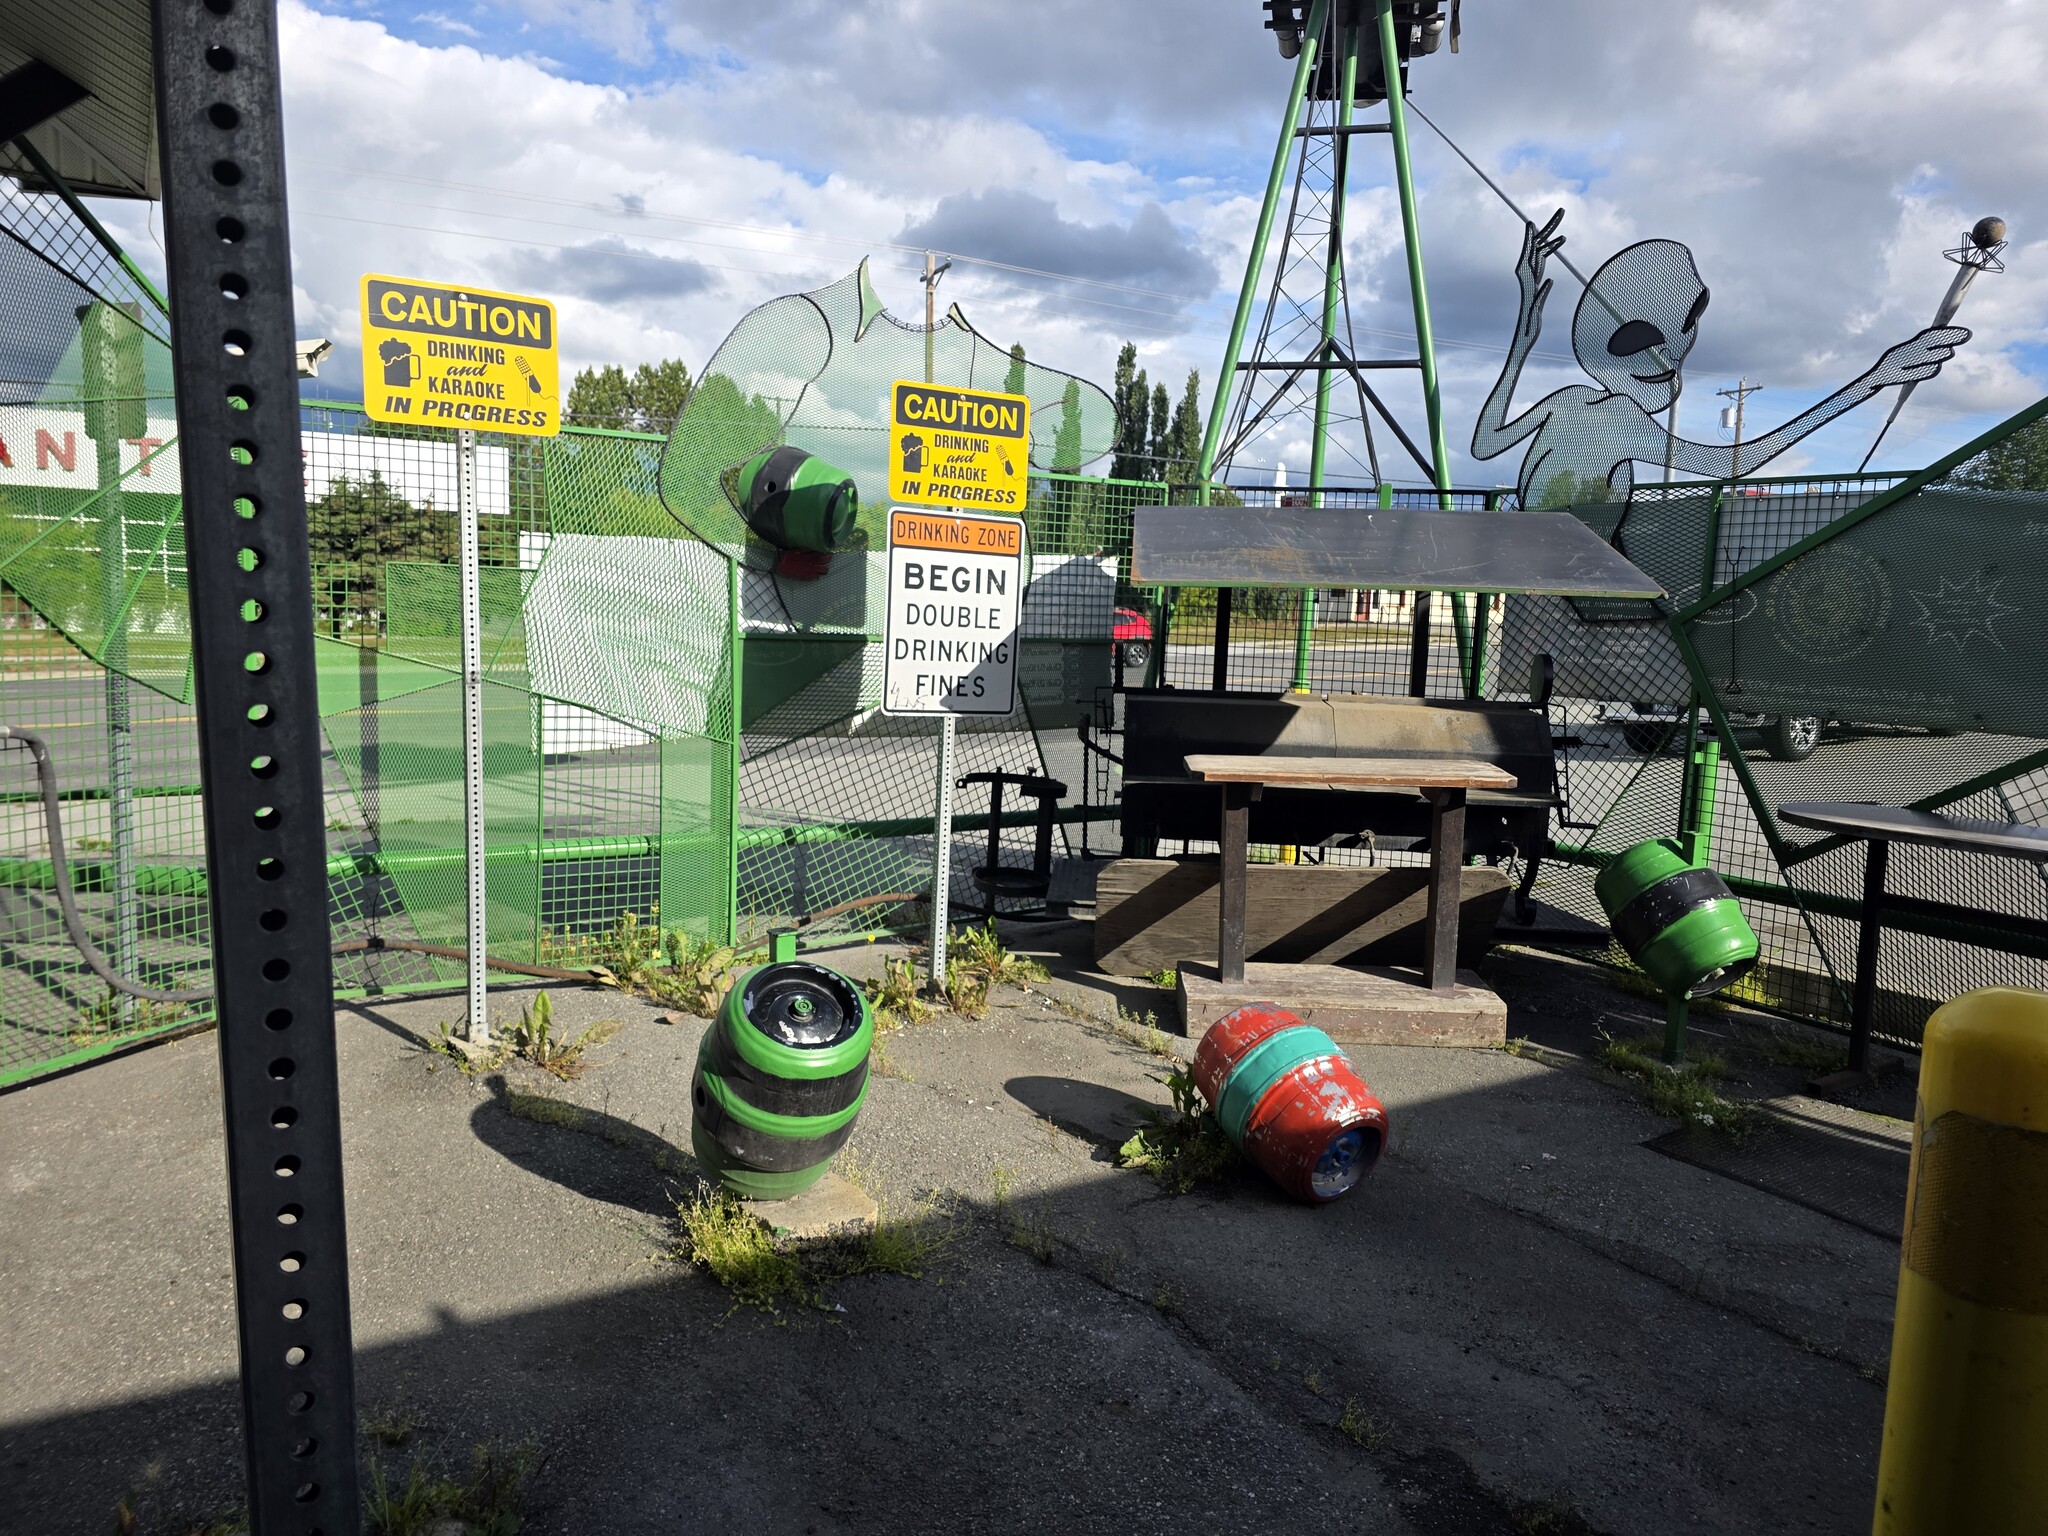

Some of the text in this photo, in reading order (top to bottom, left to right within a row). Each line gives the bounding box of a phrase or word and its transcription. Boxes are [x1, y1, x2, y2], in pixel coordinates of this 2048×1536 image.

[380, 291, 541, 340] CAUTION
[427, 340, 505, 365] DRINKING
[447, 365, 487, 377] and
[428, 376, 505, 400] KARAOKE
[385, 396, 547, 427] IN PROGRESS
[904, 394, 1017, 431] CAUTION
[934, 434, 989, 453] DRINKING
[947, 453, 975, 464] and
[933, 464, 987, 482] KARAOKE
[902, 480, 1017, 504] IN PROGRESS
[897, 520, 1016, 548] DRINKING ZONE
[904, 562, 1006, 595] BEGIN
[906, 603, 1001, 629] DOUBLE
[894, 638, 1008, 664] DRINKING
[916, 674, 985, 697] FINES
